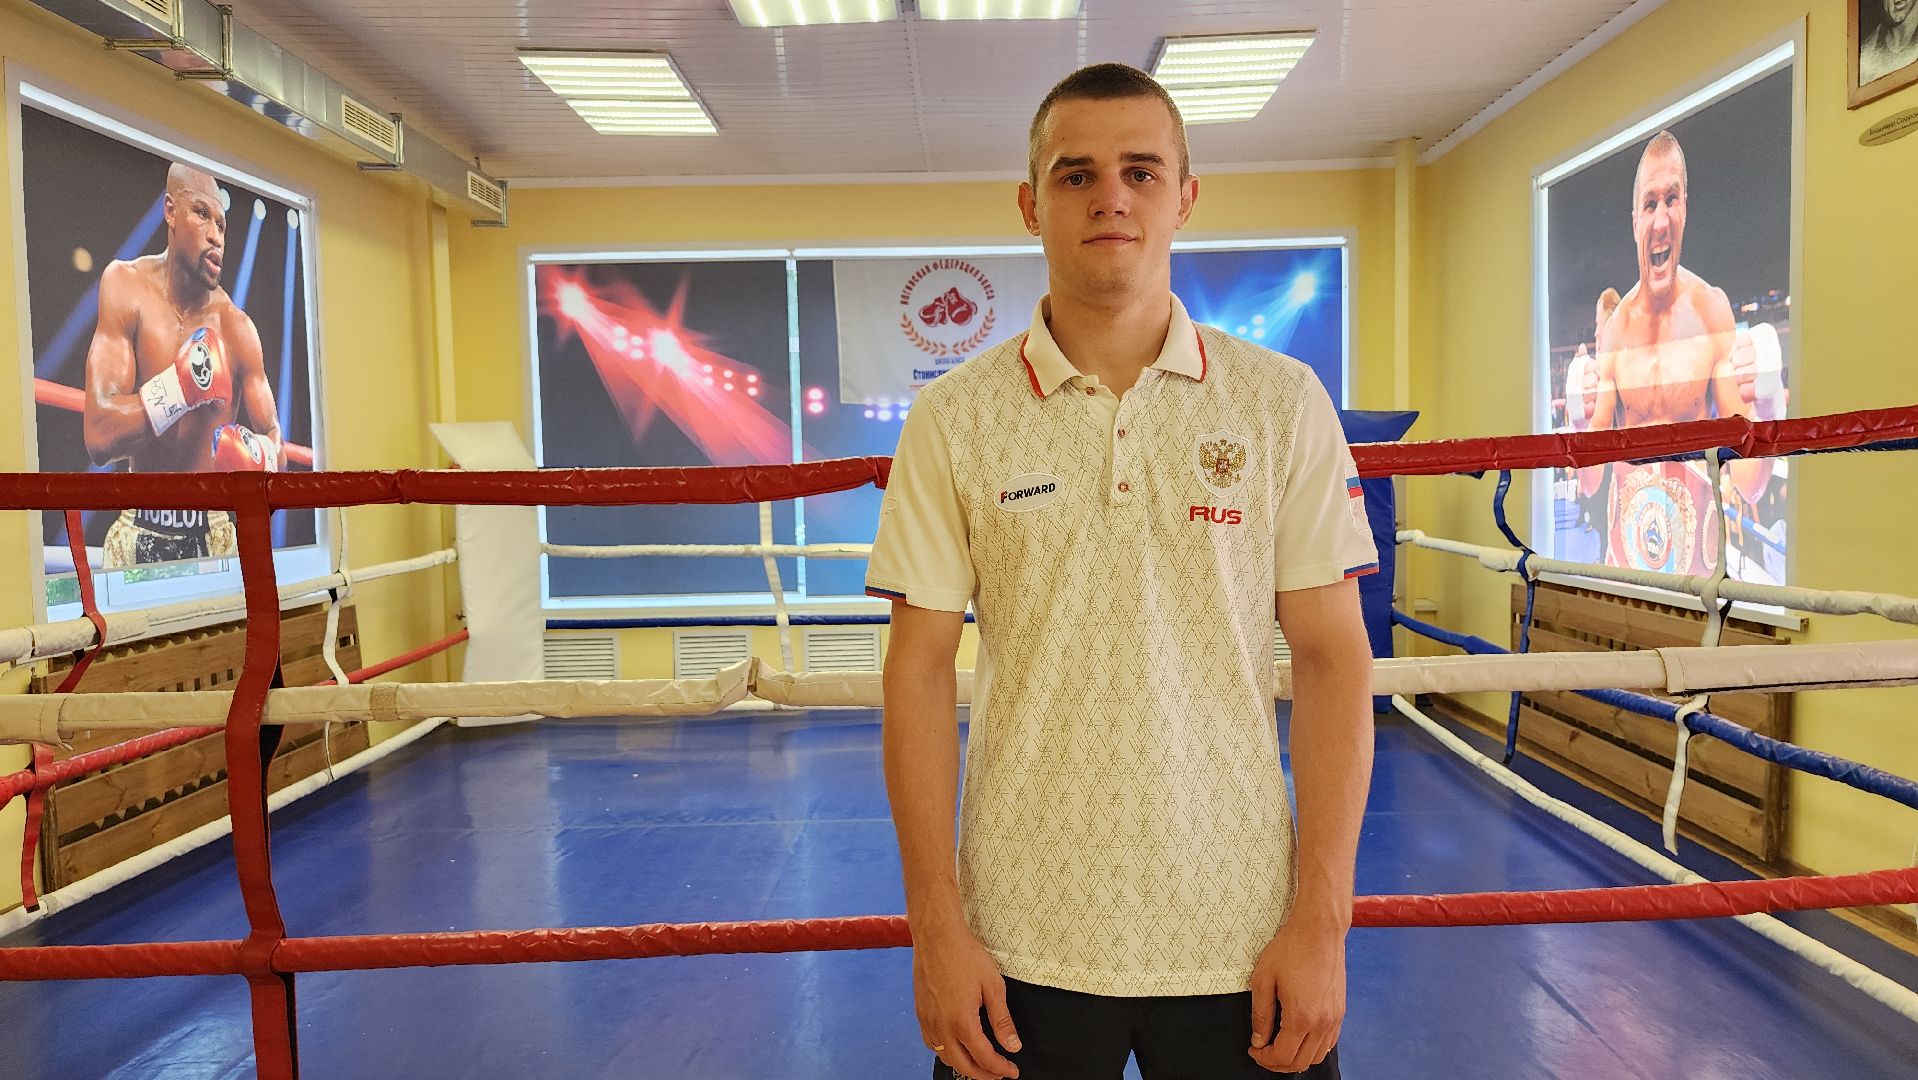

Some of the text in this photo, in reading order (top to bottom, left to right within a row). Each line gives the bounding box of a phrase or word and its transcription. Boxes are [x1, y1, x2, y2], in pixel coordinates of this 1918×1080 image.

[932, 258, 980, 279] ФЕДЕРАЦИЯ
[977, 274, 996, 301] БОКСА
[1000, 482, 1056, 504] FORWARD
[1189, 505, 1242, 525] RUS
